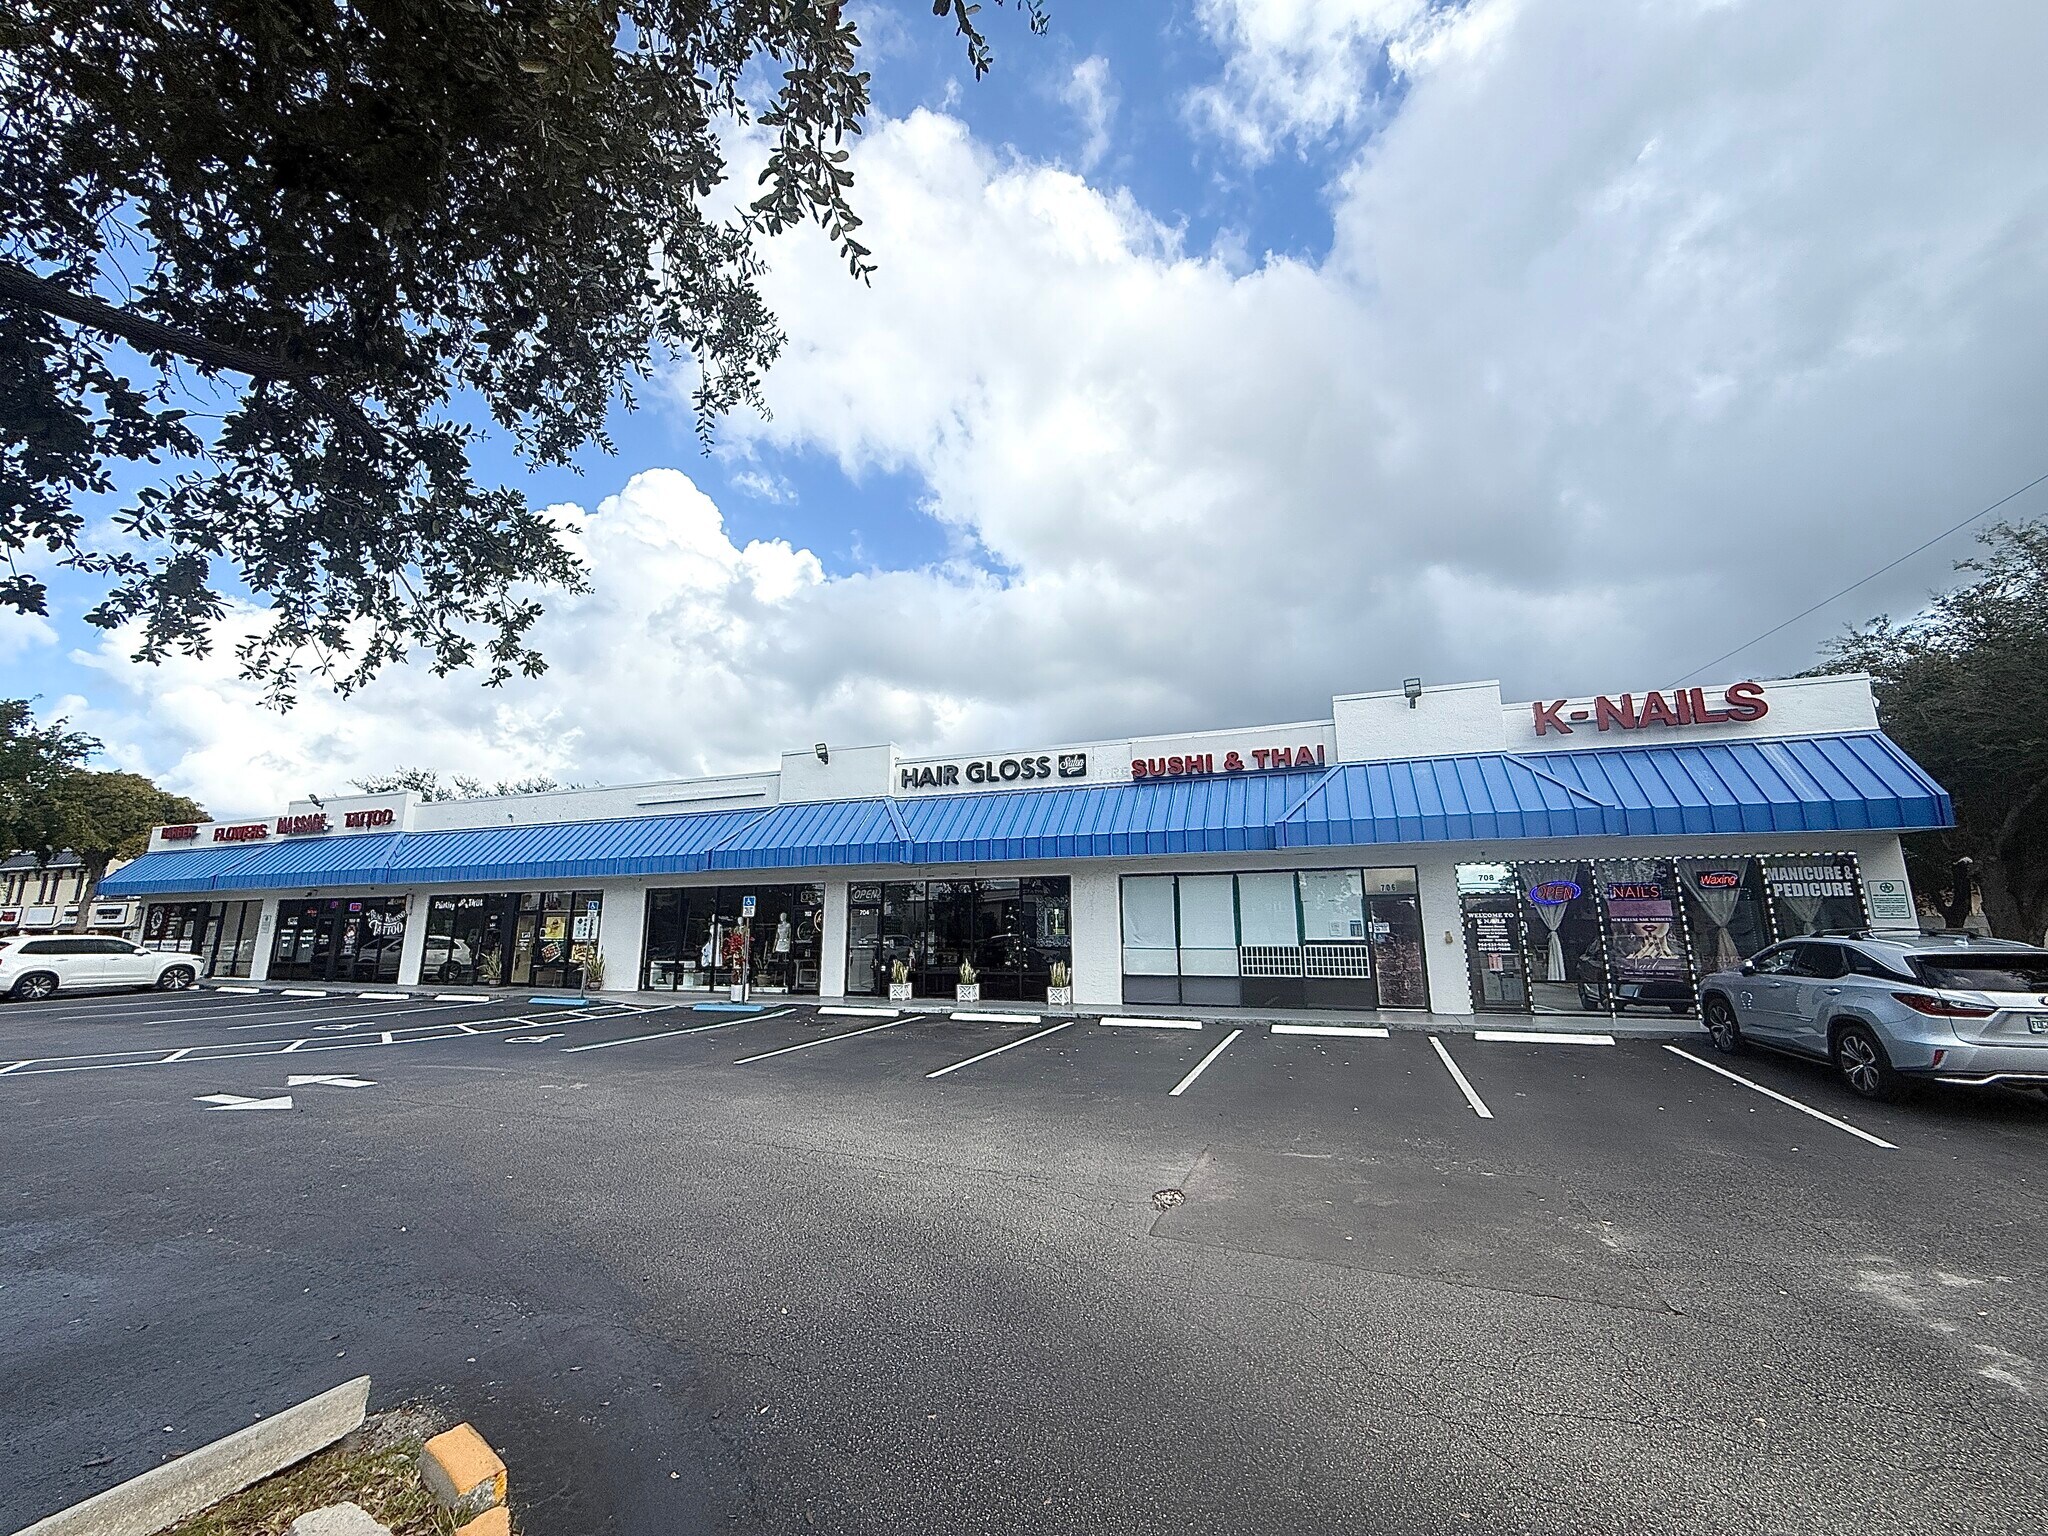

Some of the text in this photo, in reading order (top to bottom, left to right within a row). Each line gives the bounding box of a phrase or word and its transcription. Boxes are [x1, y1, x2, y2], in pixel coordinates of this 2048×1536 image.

[1533, 681, 1769, 736] K-NAILS
[1131, 754, 1213, 778] SUSHI
[1223, 751, 1245, 770] &
[1252, 745, 1326, 769] THAI
[901, 756, 1052, 789] HAIR GLOSS
[276, 813, 328, 835] MASSAGE
[344, 809, 394, 829] TATTOO
[212, 824, 268, 842] FLOWERS
[1700, 874, 1736, 886] Waxing
[1766, 865, 1854, 881] MANICURE &
[854, 889, 879, 899] OPEN
[1537, 885, 1573, 900] OPEN
[1612, 886, 1660, 898] NAILS
[1772, 882, 1854, 897] PEDICURE
